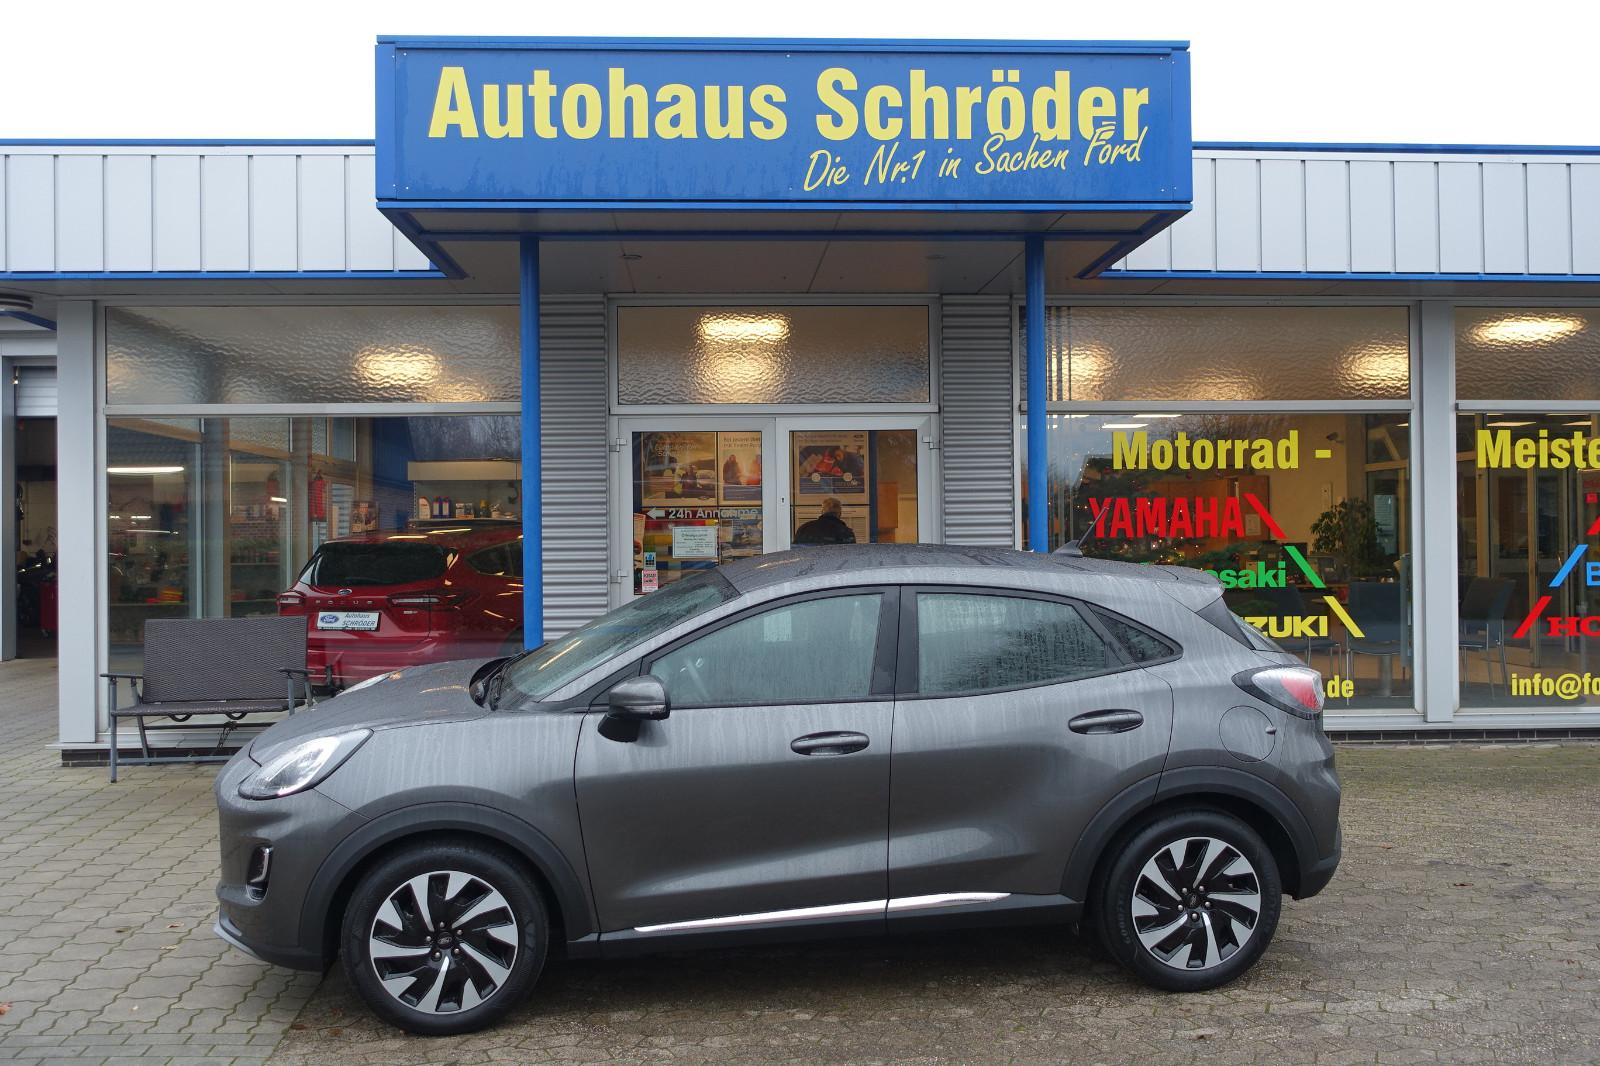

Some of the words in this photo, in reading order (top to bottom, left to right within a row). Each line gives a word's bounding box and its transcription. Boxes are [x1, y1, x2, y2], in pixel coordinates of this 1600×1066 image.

[428, 66, 788, 140] Autohaus
[815, 66, 1149, 142] Schröder
[803, 149, 850, 191] Die
[863, 142, 926, 186] Nr.1
[938, 147, 963, 179] in
[974, 133, 1069, 175] Sachen
[1083, 121, 1149, 167] Ford
[1112, 429, 1299, 471] Motorrad
[668, 508, 692, 519] 24h
[1088, 496, 1245, 539] YAMAHA
